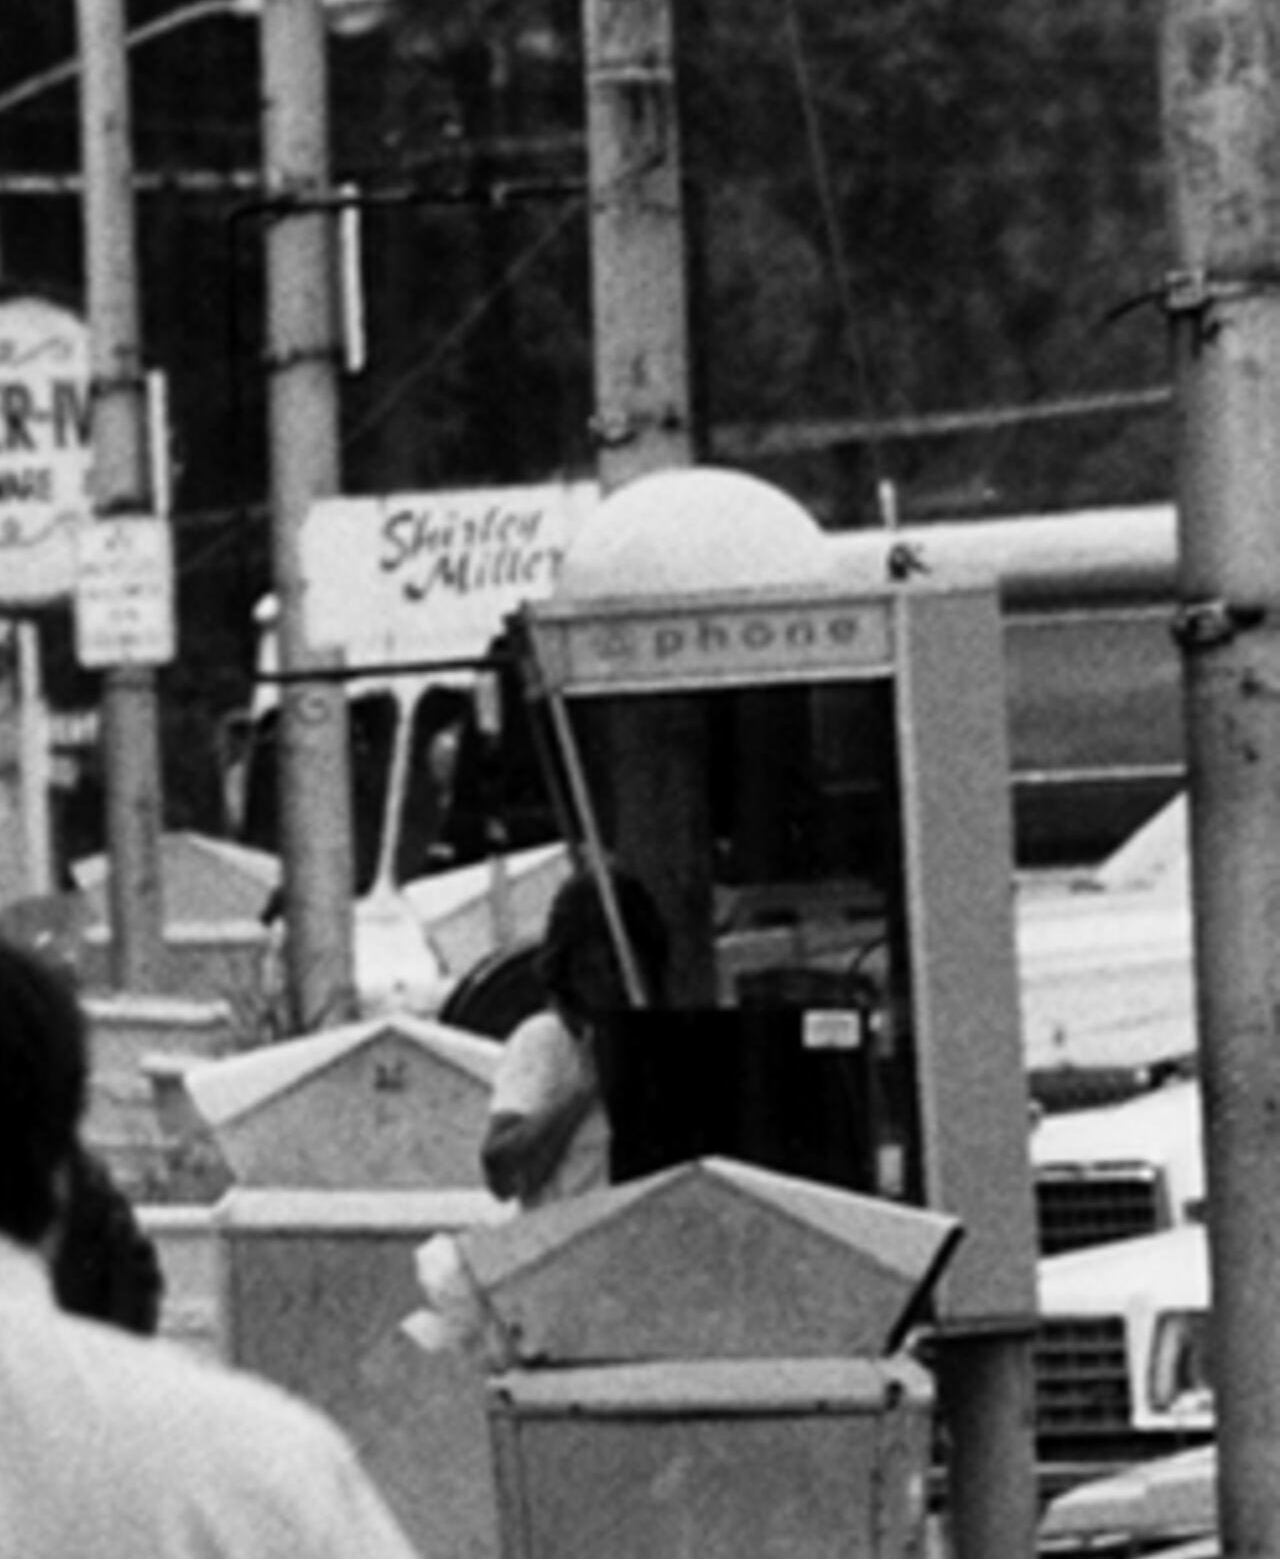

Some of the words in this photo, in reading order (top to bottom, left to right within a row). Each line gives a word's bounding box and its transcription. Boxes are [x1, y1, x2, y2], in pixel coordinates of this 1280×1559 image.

[381, 506, 542, 572] Shirley
[404, 547, 568, 601] Miller
[653, 612, 860, 660] phone
